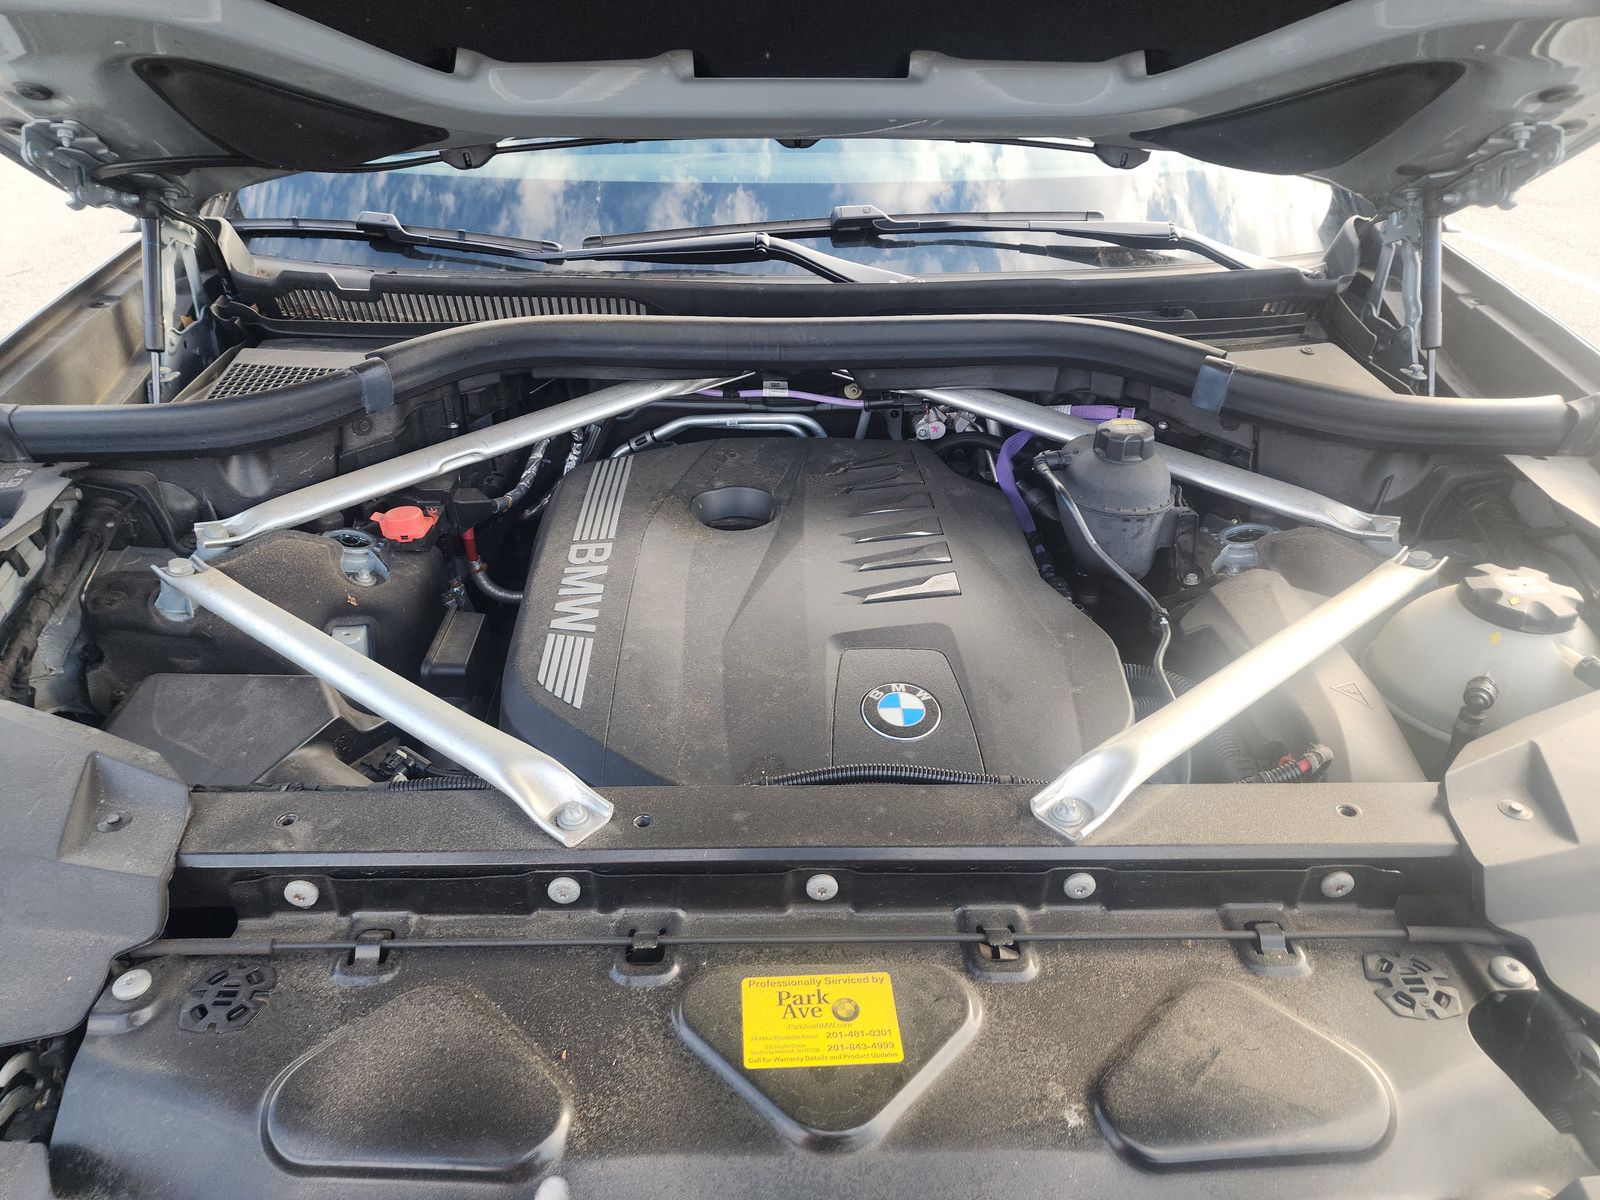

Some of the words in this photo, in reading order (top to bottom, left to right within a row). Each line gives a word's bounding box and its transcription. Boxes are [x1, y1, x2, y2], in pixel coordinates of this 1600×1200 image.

[550, 542, 613, 632] BMW
[869, 684, 932, 701] BMW
[748, 978, 822, 988] Professionally
[824, 976, 869, 985] Serviced
[872, 976, 884, 984] by
[777, 989, 830, 1006] Park
[782, 1003, 823, 1019] Ave
[826, 1029, 892, 1039] 201-481-0301
[827, 1042, 895, 1052] 201-843-4999
[871, 1052, 899, 1060] Updates
